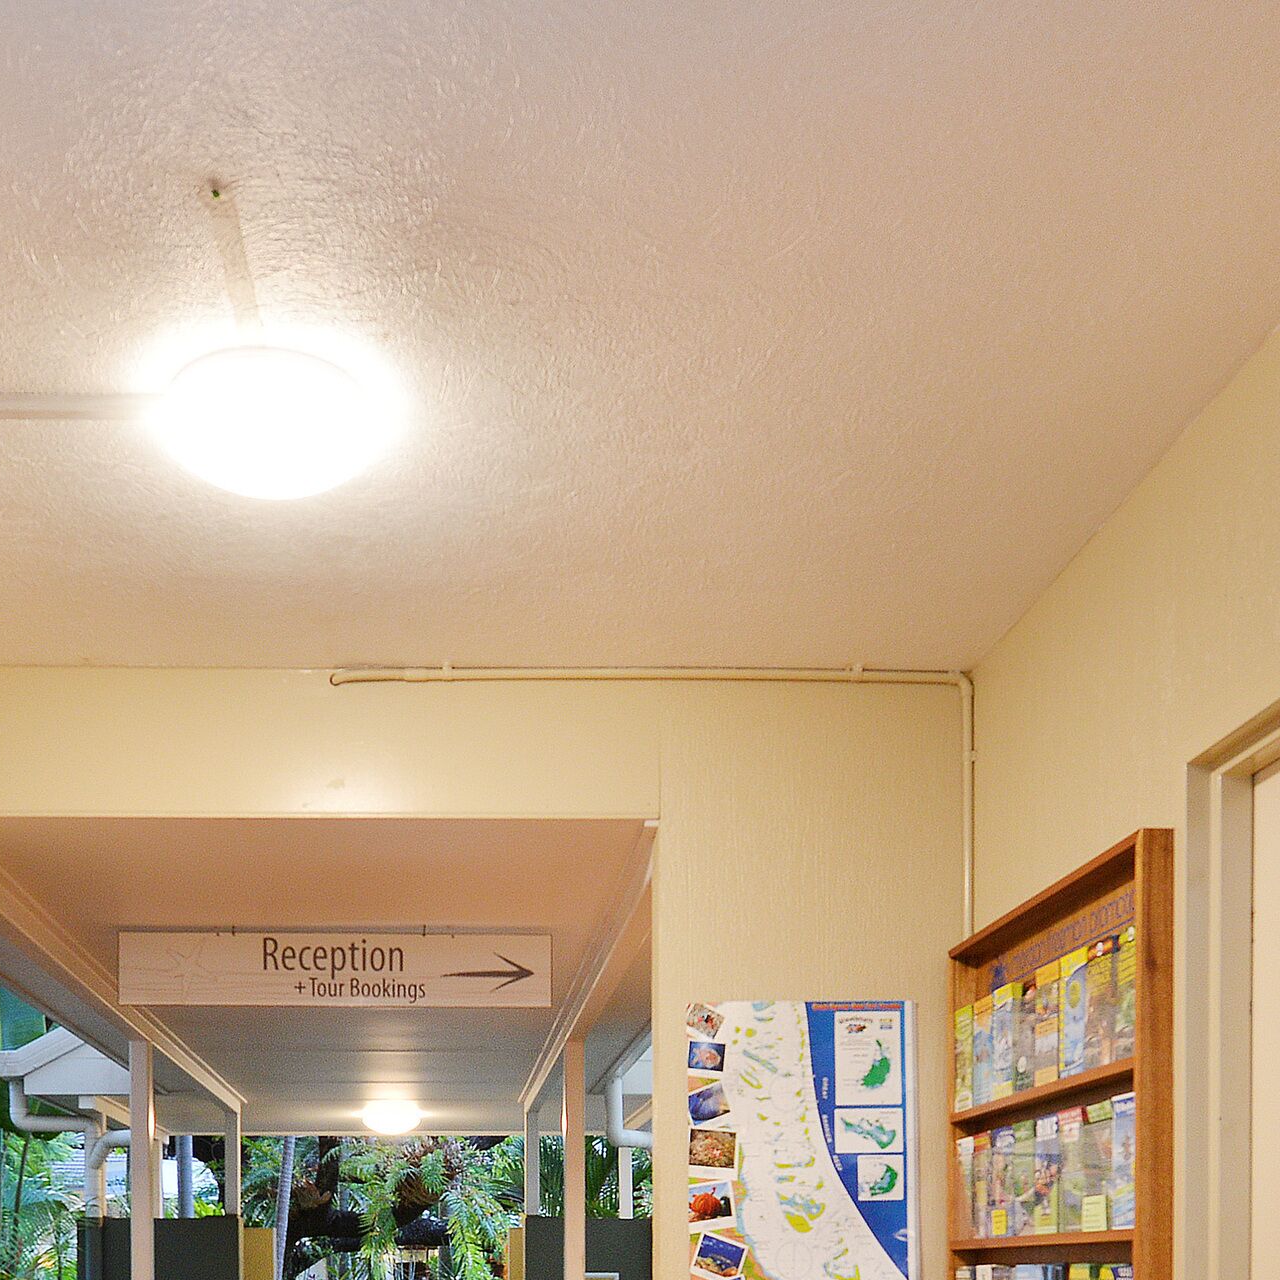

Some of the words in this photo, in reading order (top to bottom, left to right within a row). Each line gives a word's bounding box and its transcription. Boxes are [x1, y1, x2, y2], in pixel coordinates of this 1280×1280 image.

[262, 937, 404, 978] Reception
[309, 977, 346, 998] Tour
[349, 978, 427, 1004] Bookings
